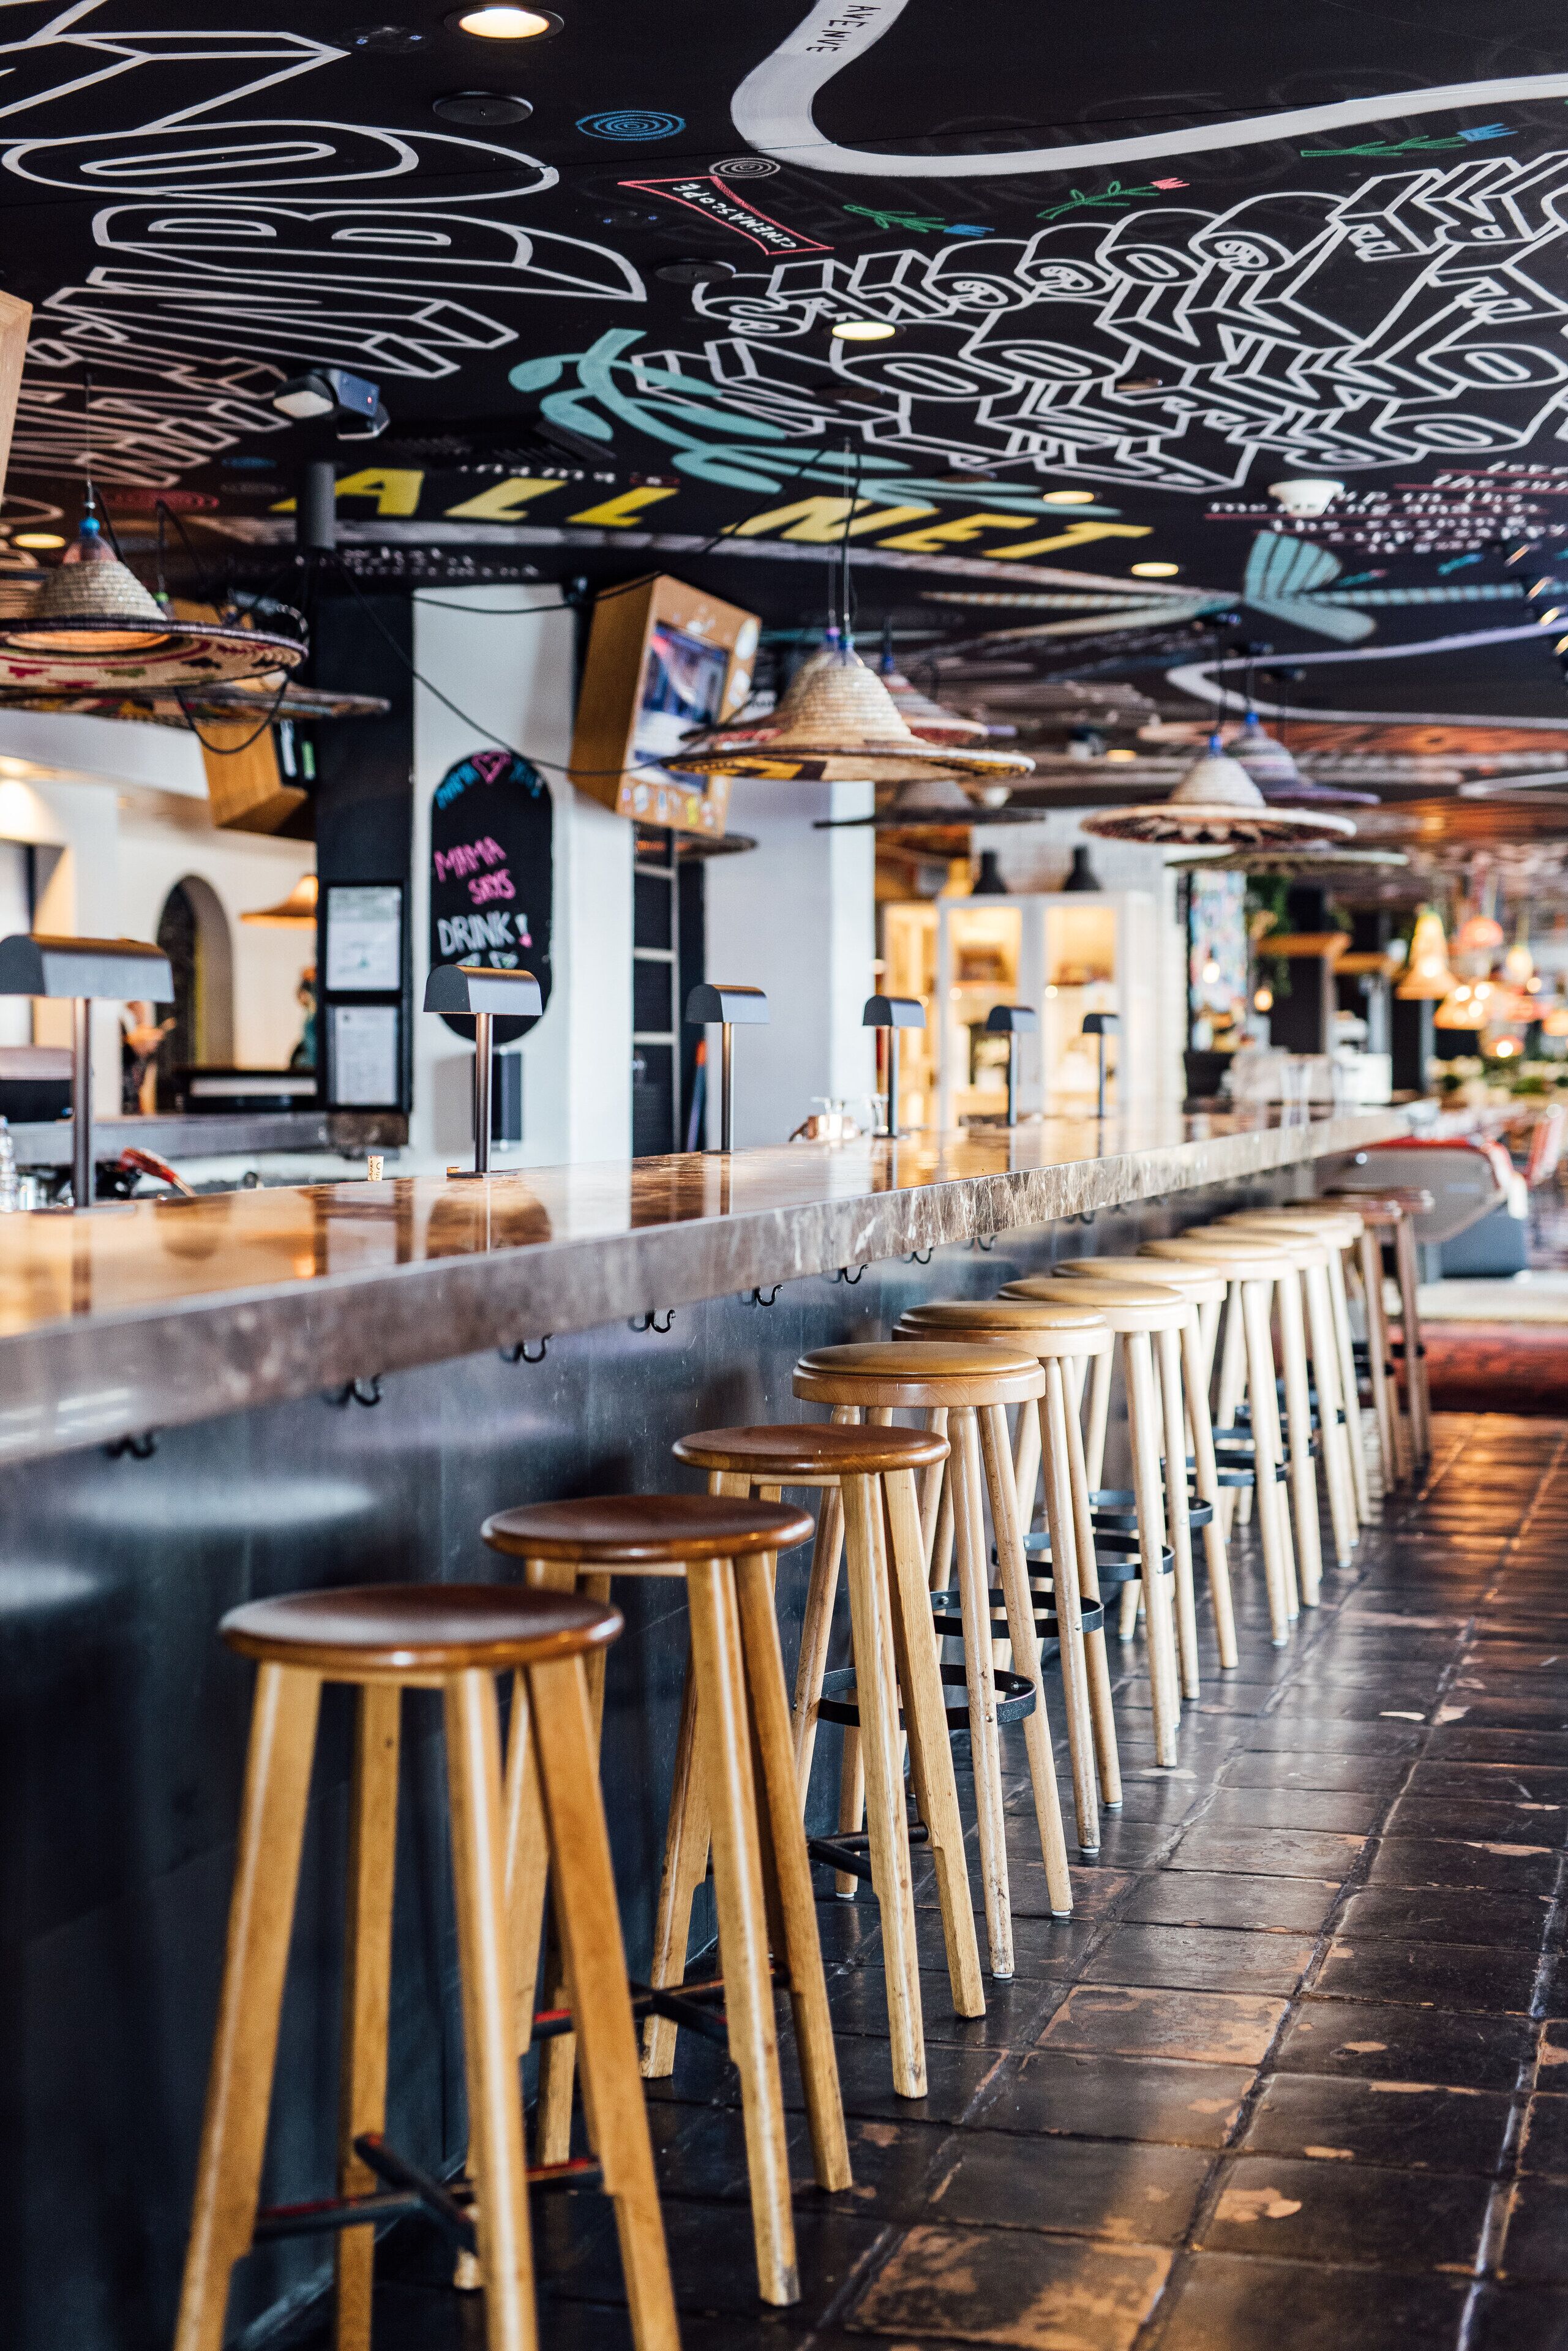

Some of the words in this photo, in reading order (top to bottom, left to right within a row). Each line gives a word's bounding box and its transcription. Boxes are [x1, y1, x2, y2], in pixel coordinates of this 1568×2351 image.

[672, 182, 798, 249] CINEMASCOPE
[1329, 160, 1568, 262] RE
[692, 202, 1326, 337] GOGGLES
[631, 263, 1409, 436] MOON
[864, 331, 1568, 470] OMENT
[1228, 395, 1568, 470] OR
[271, 468, 680, 528] ALL
[721, 495, 1155, 560] NET
